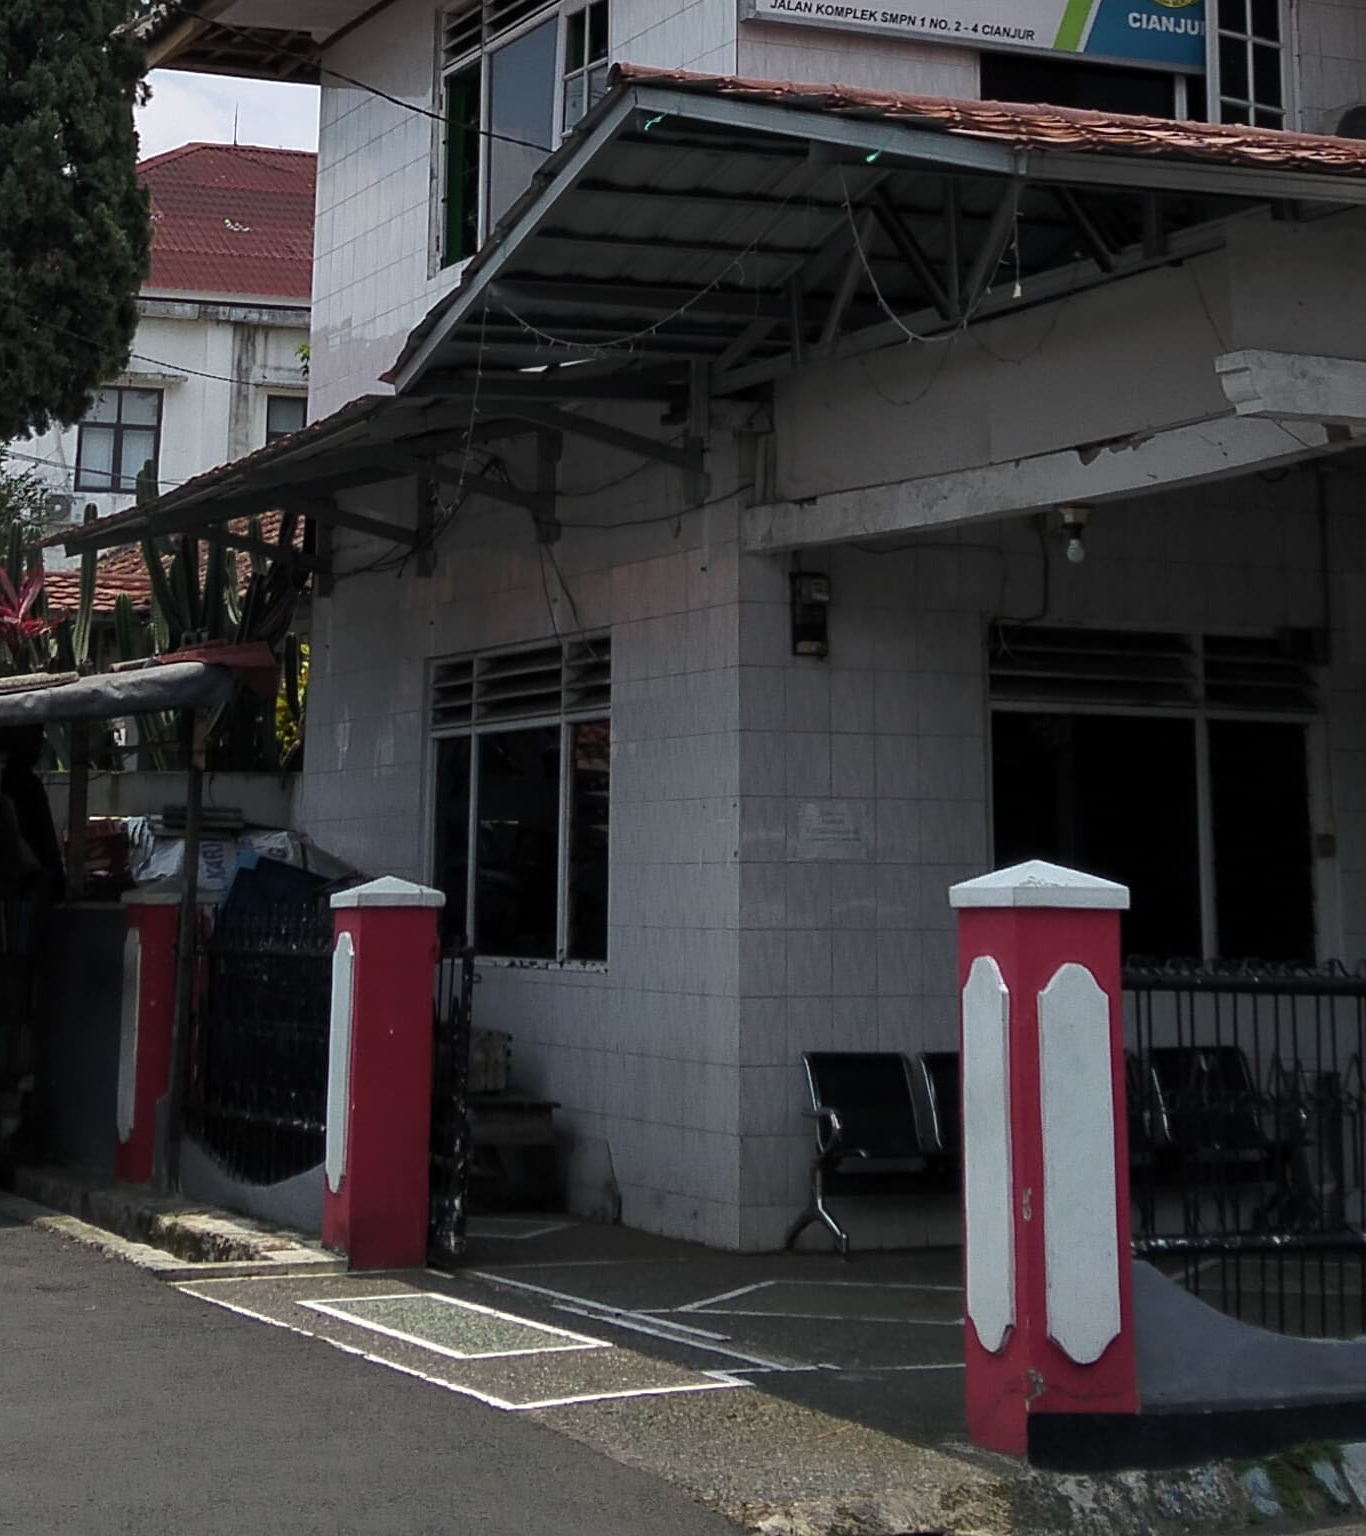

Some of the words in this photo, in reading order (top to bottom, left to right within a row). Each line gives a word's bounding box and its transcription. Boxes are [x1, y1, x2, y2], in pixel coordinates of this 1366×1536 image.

[815, 4, 878, 22] KOMPLEK
[880, 11, 916, 26] SMPN
[919, 16, 926, 27] 1
[929, 18, 951, 31] NO.
[954, 21, 961, 32] 2
[971, 23, 979, 33] 4
[982, 24, 1035, 41] CIANJUR
